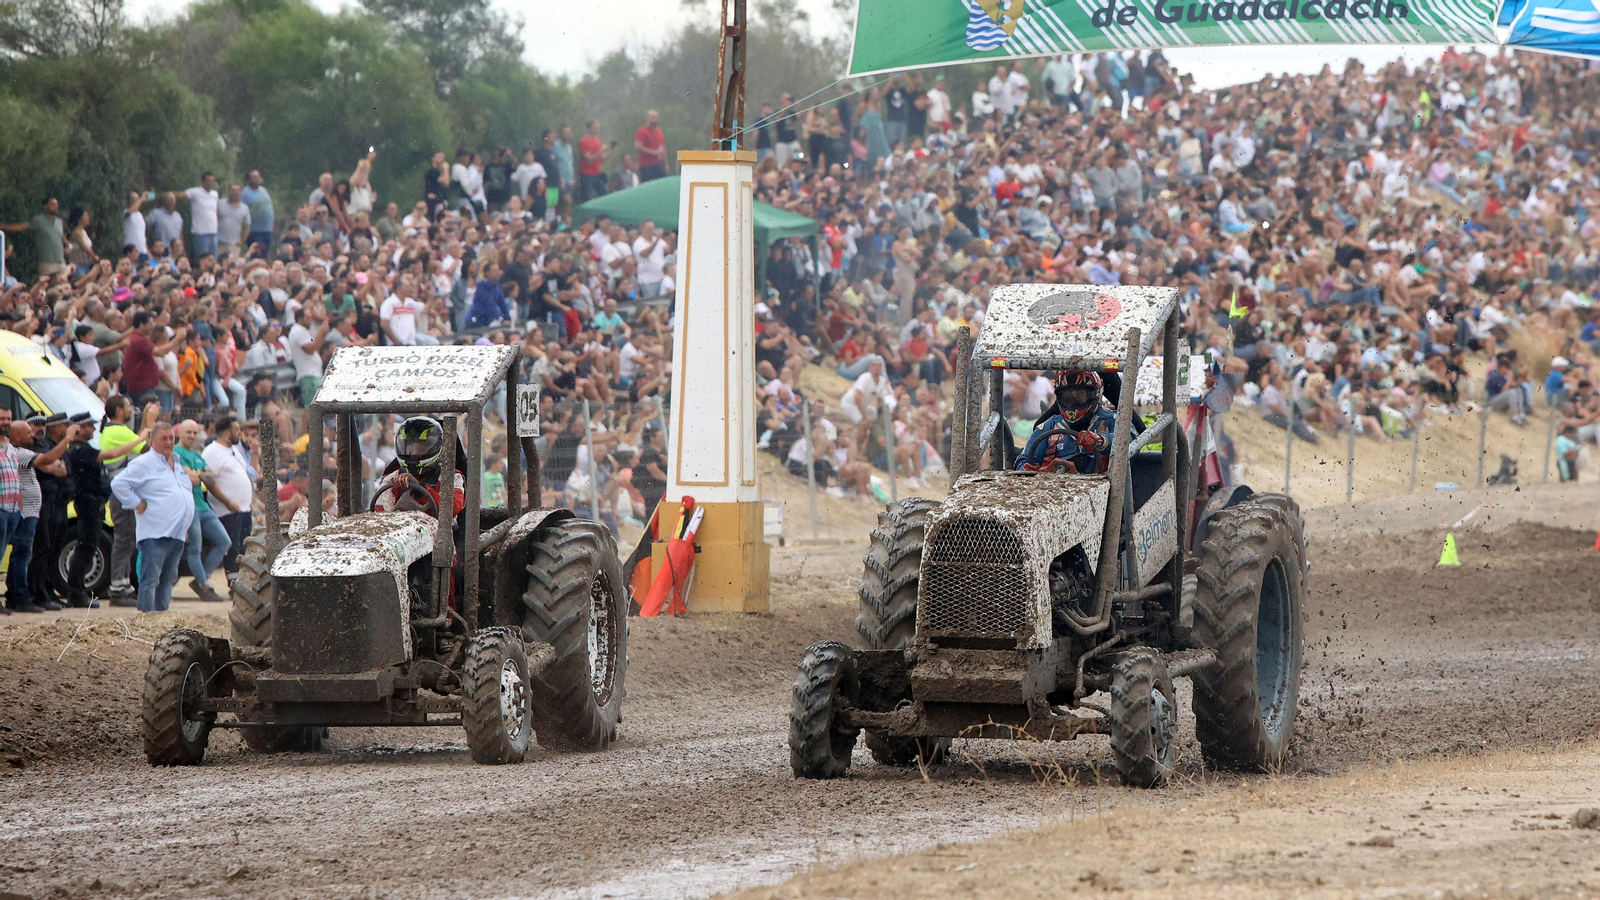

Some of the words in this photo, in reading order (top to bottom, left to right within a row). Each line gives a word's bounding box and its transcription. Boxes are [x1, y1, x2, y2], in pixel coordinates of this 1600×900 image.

[1091, 0, 1138, 28] de
[351, 355, 421, 368] TURBO
[427, 355, 486, 368] DIESEL
[375, 368, 460, 379] CAMPOS
